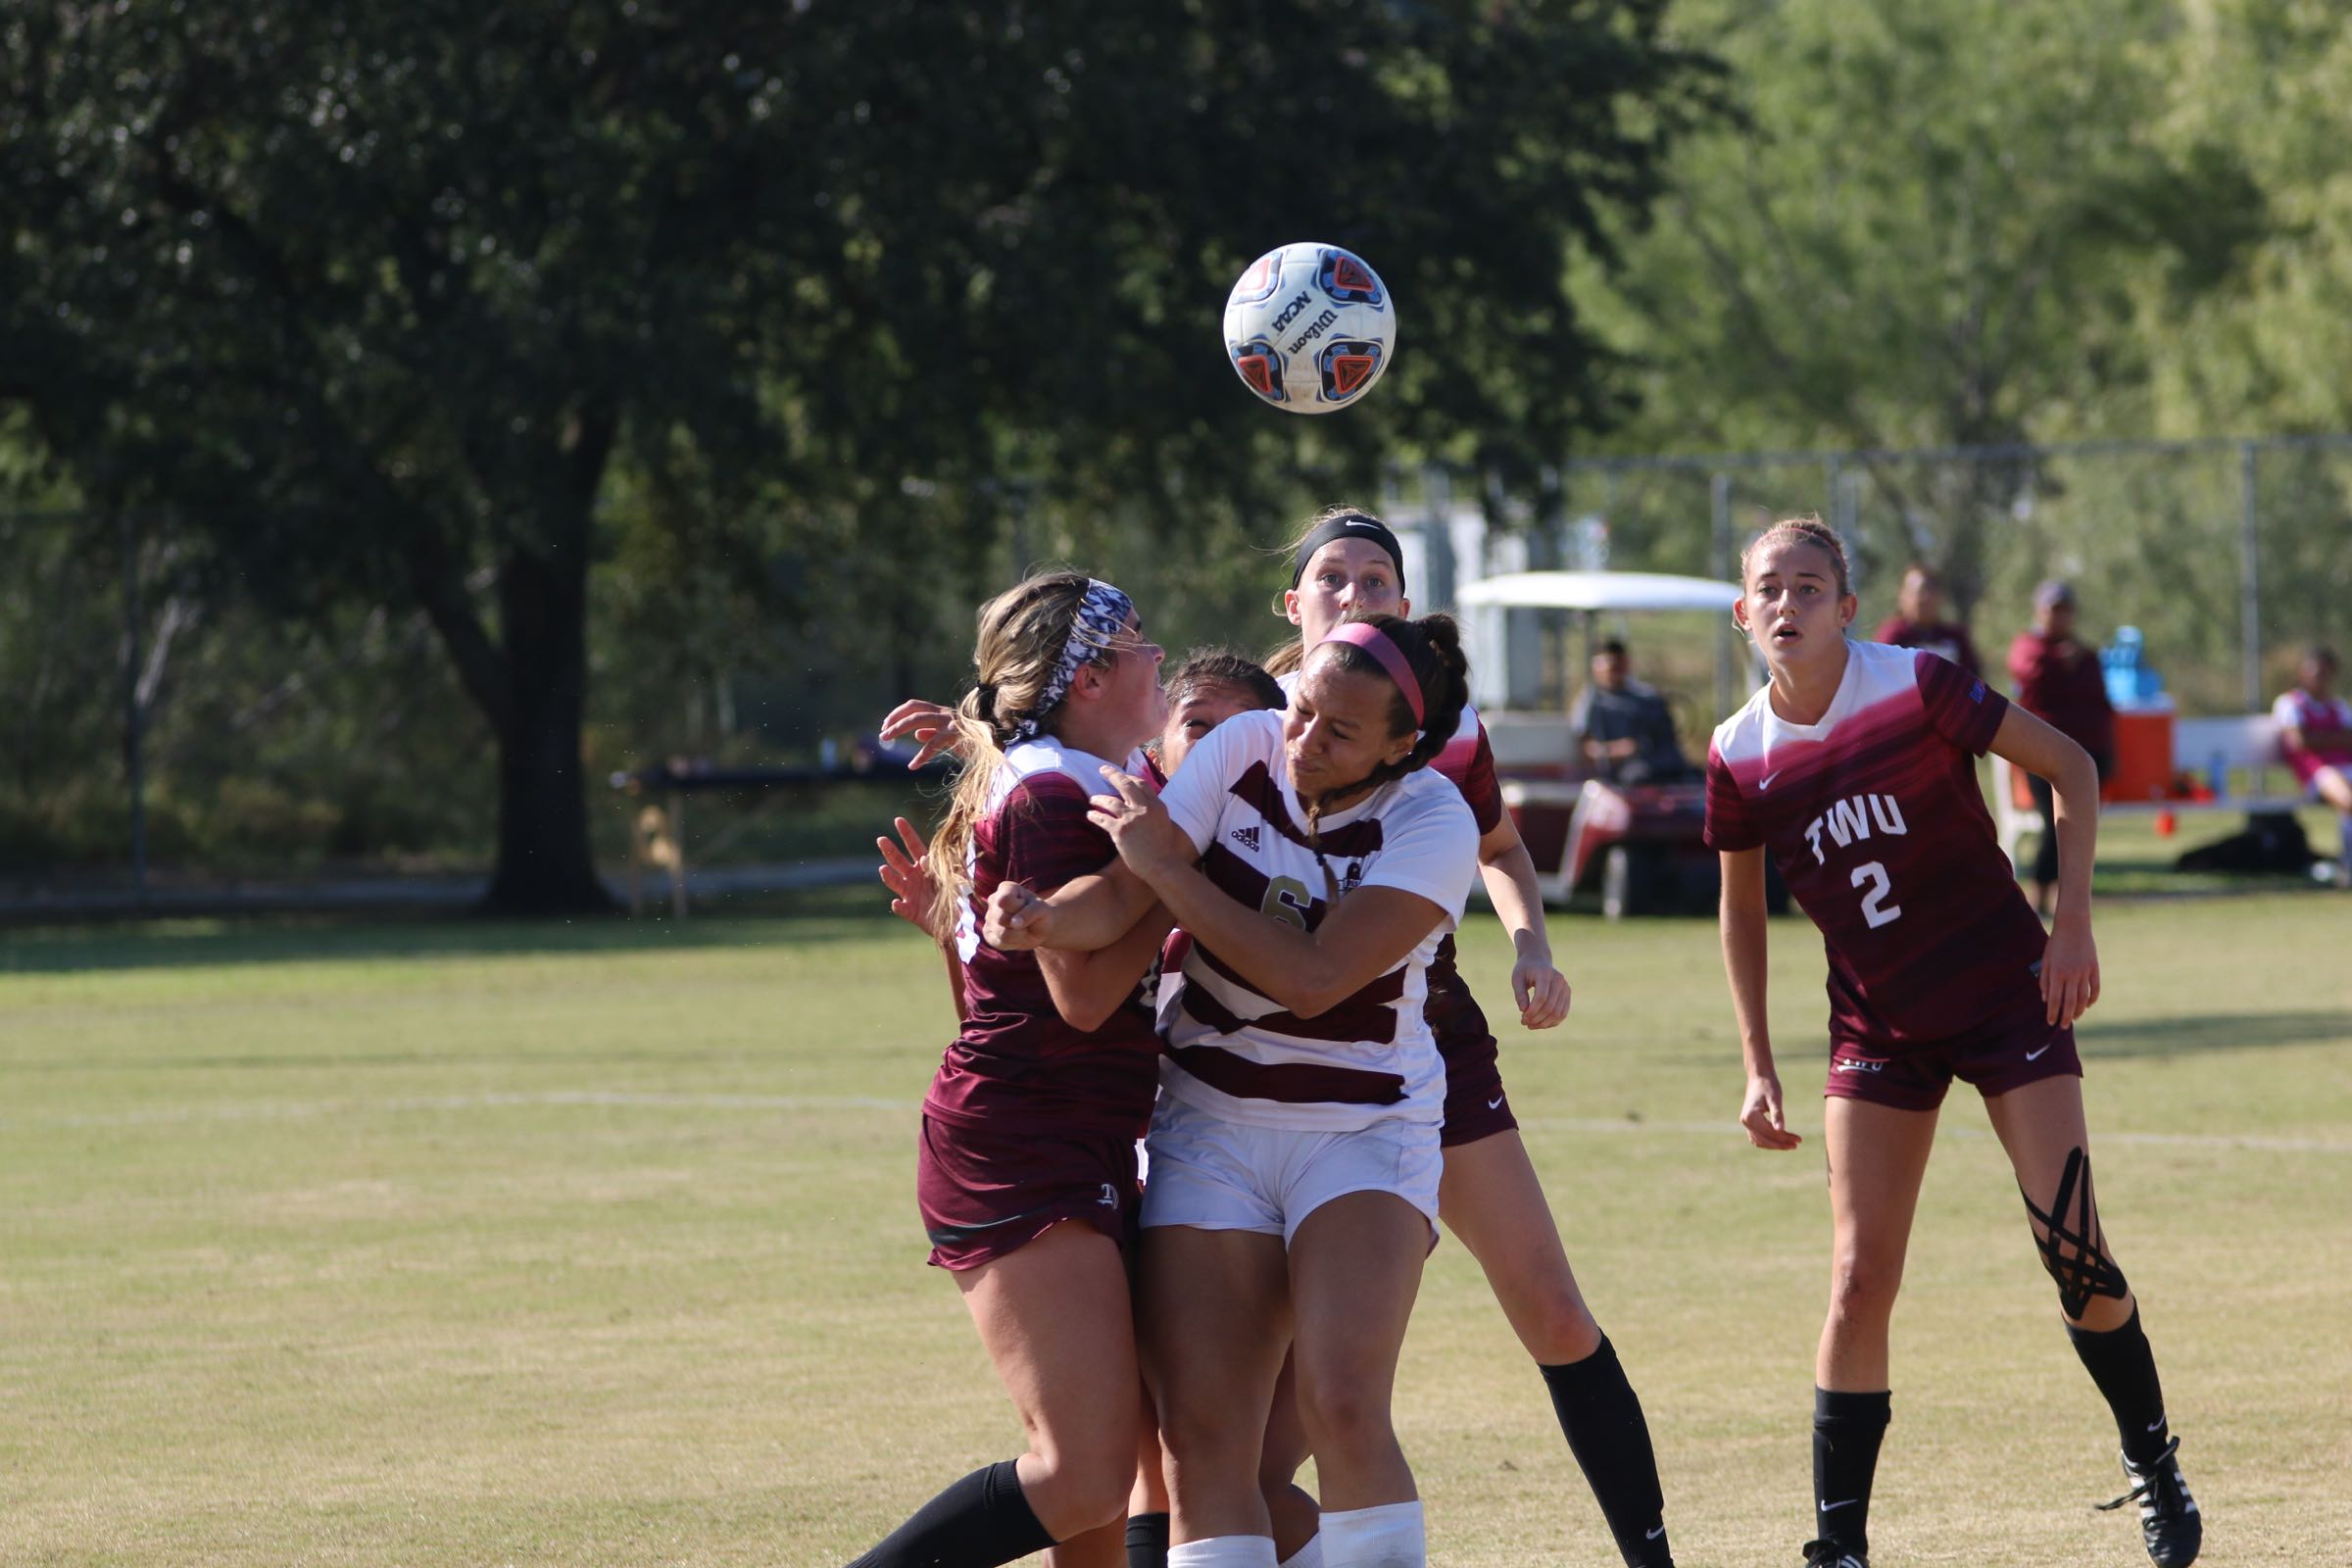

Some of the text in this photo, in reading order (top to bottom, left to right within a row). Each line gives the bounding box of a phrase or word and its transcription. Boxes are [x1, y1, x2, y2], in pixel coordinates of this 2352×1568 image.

[1271, 290, 1312, 333] NCAA
[1287, 309, 1339, 355] Wilson
[1231, 830, 1260, 853] adidas
[1804, 793, 1907, 866] TWU
[1850, 860, 1902, 930] 2
